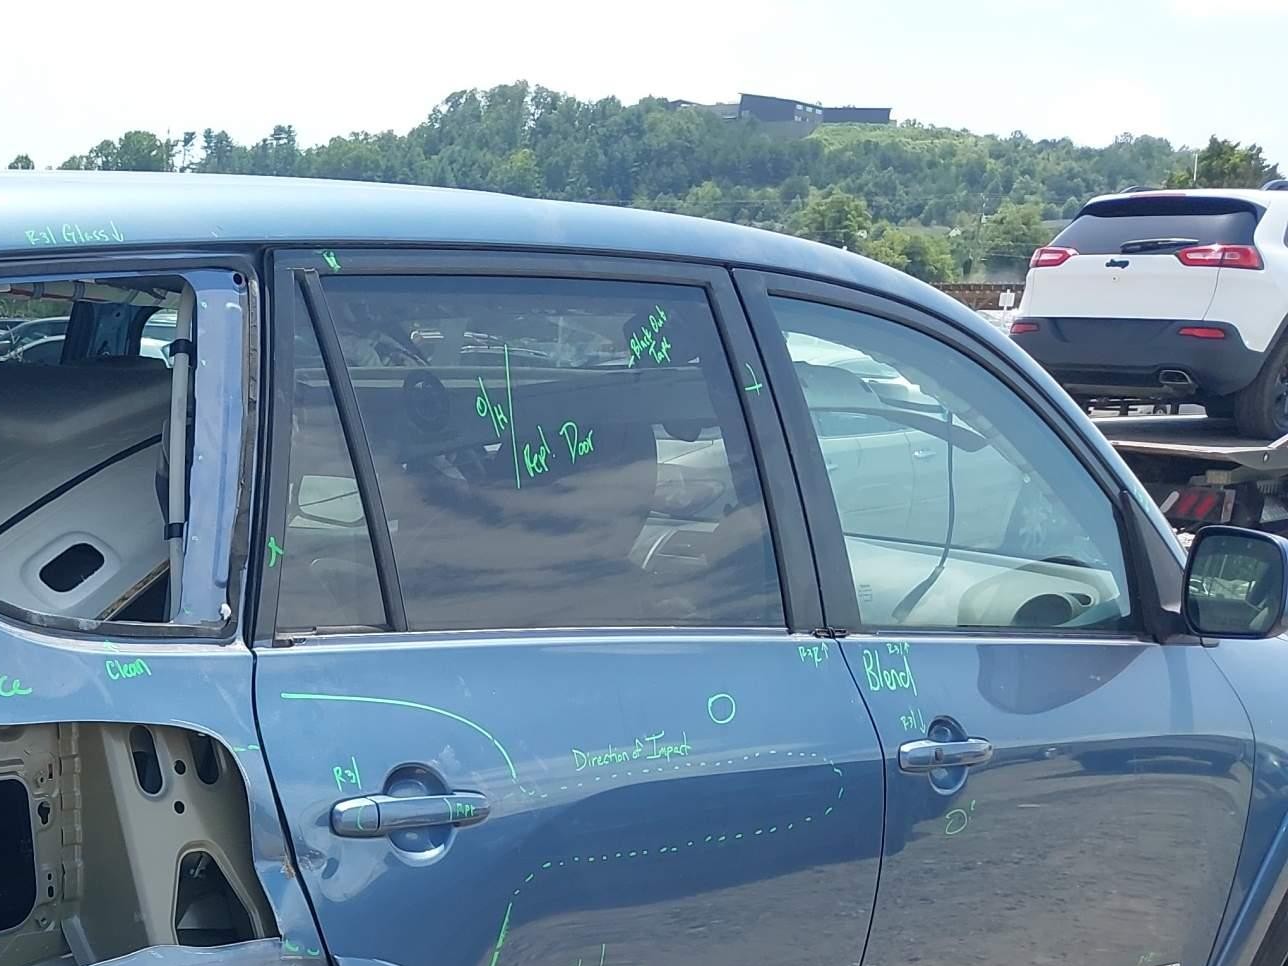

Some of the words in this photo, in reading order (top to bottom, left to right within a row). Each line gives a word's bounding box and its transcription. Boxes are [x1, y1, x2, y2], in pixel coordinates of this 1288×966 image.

[559, 421, 594, 465] Door
[862, 649, 918, 697] Blend
[571, 744, 630, 772] Direction
[645, 730, 692, 763] Impact
